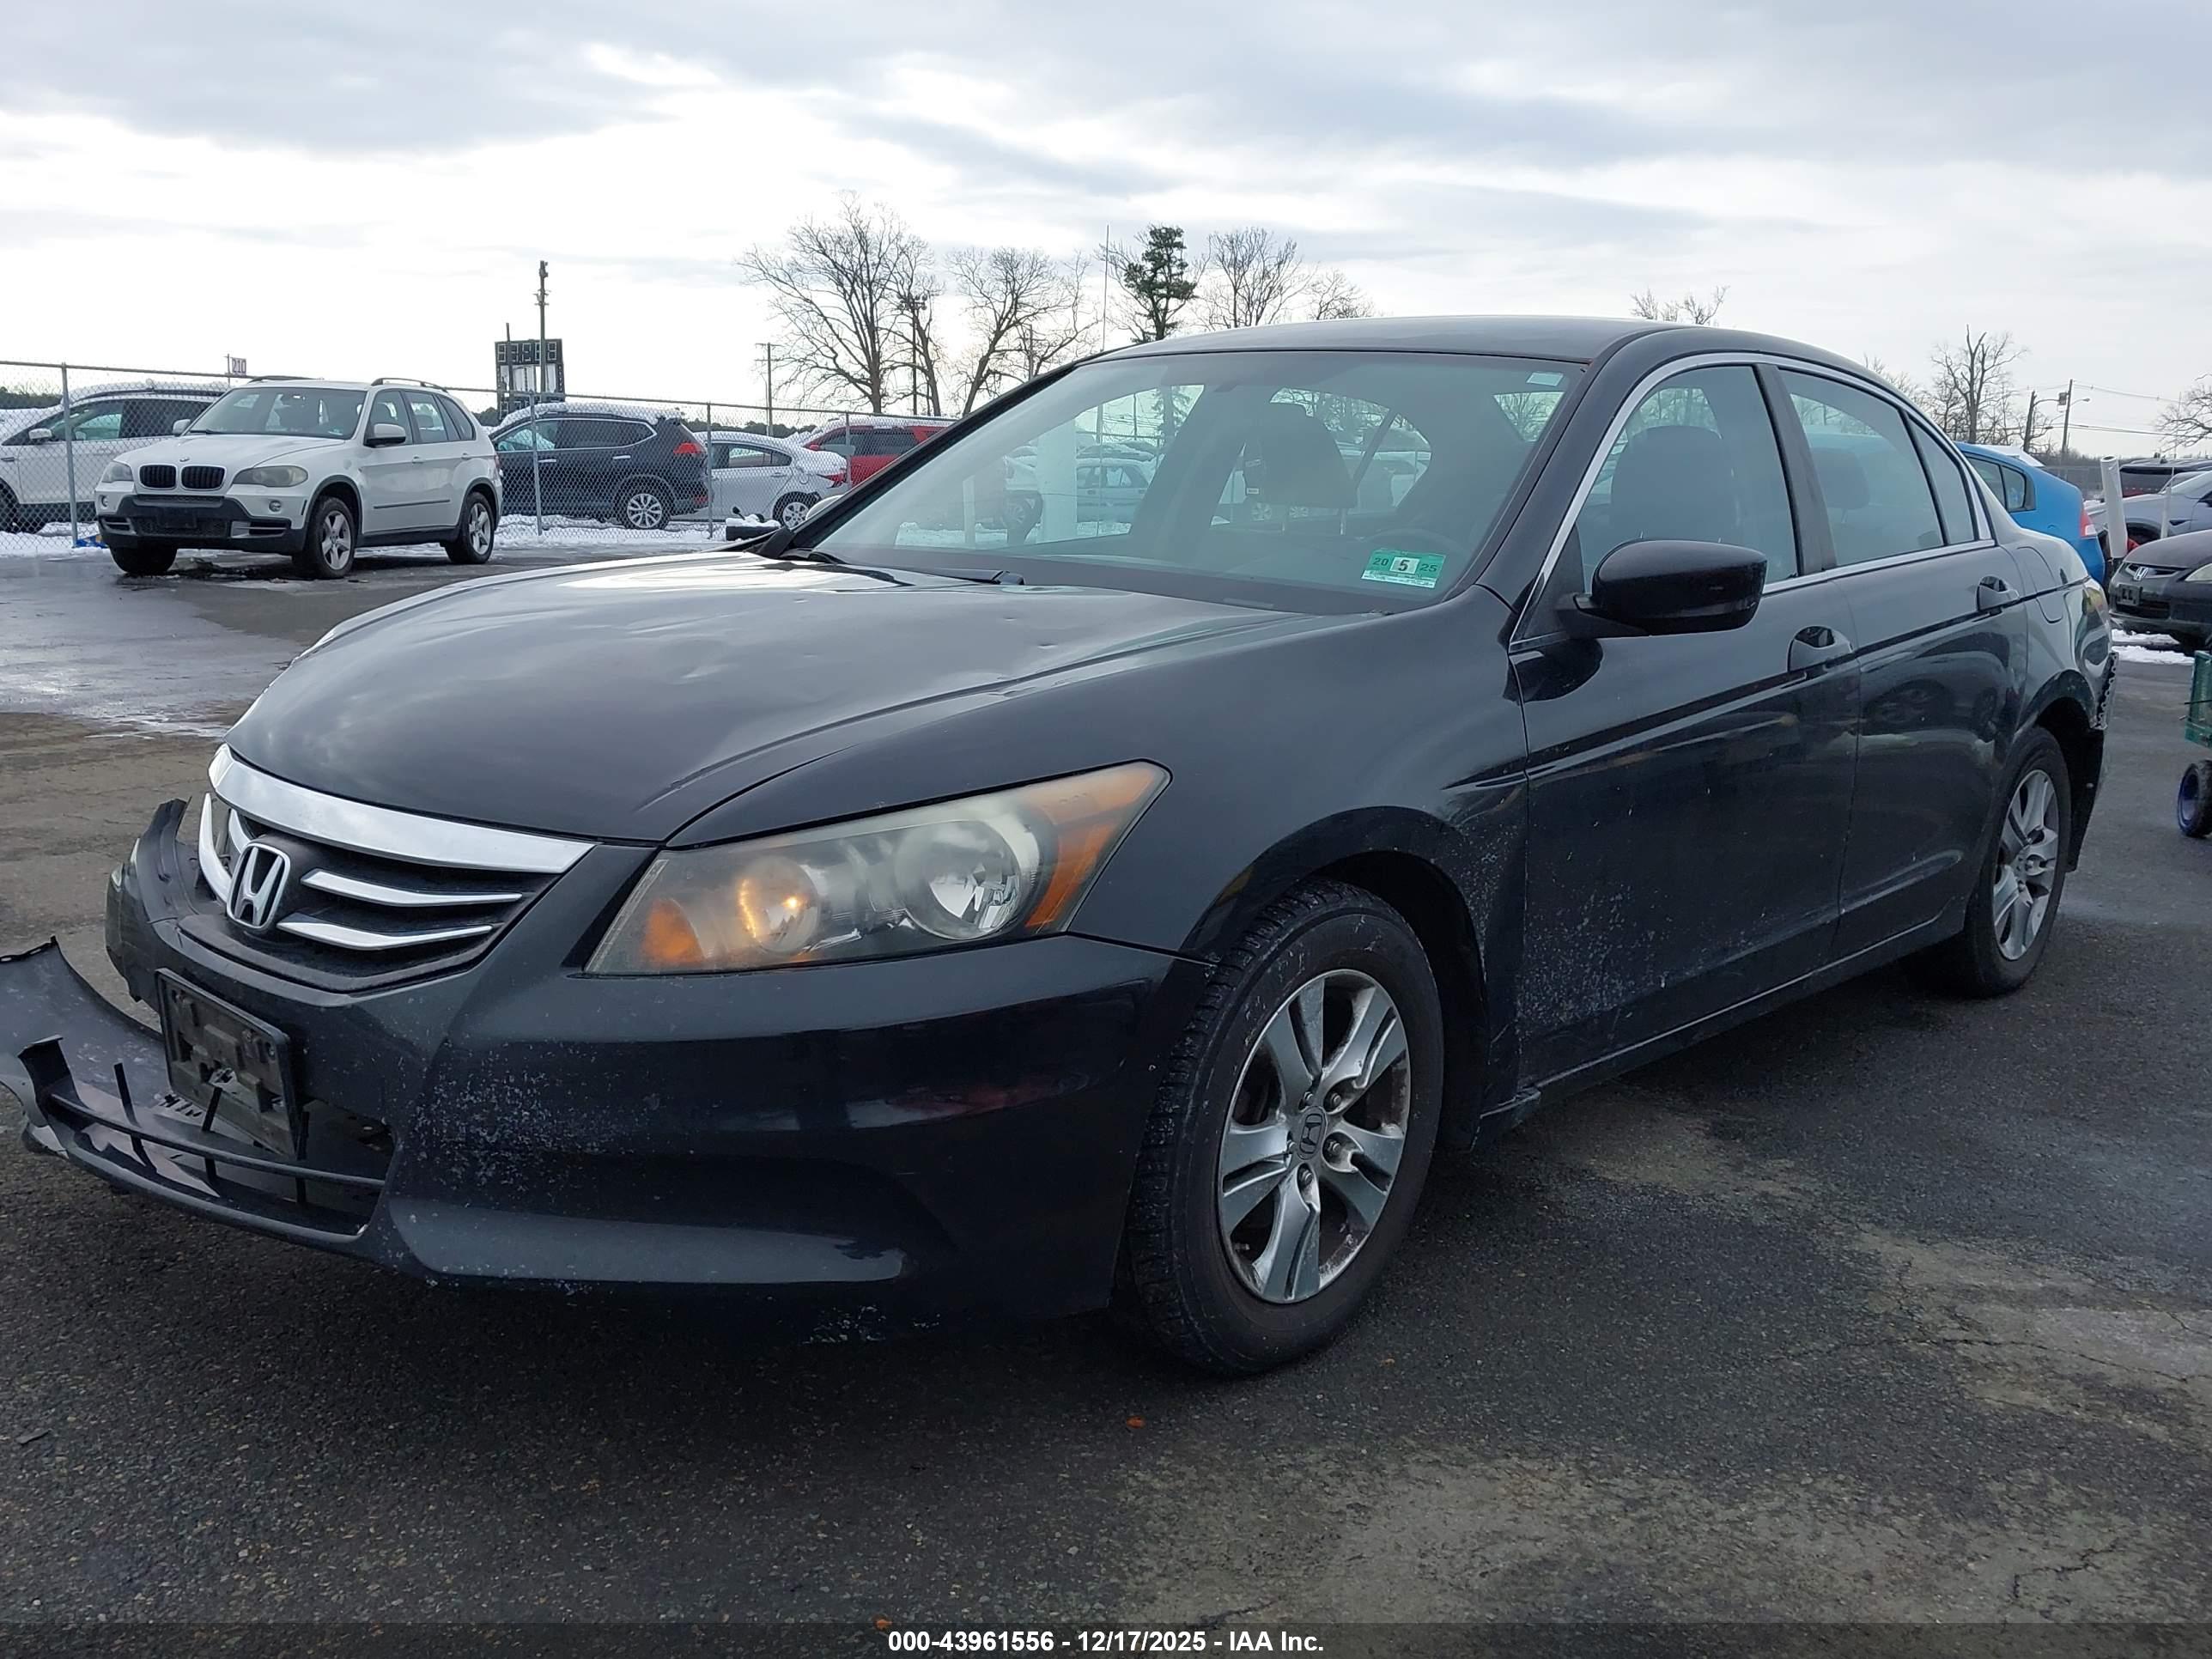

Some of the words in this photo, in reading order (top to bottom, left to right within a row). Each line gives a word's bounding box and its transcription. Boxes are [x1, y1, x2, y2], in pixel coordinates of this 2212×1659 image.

[232, 358, 246, 374] 210
[1399, 559, 1410, 571] 5
[1419, 563, 1438, 572] 25
